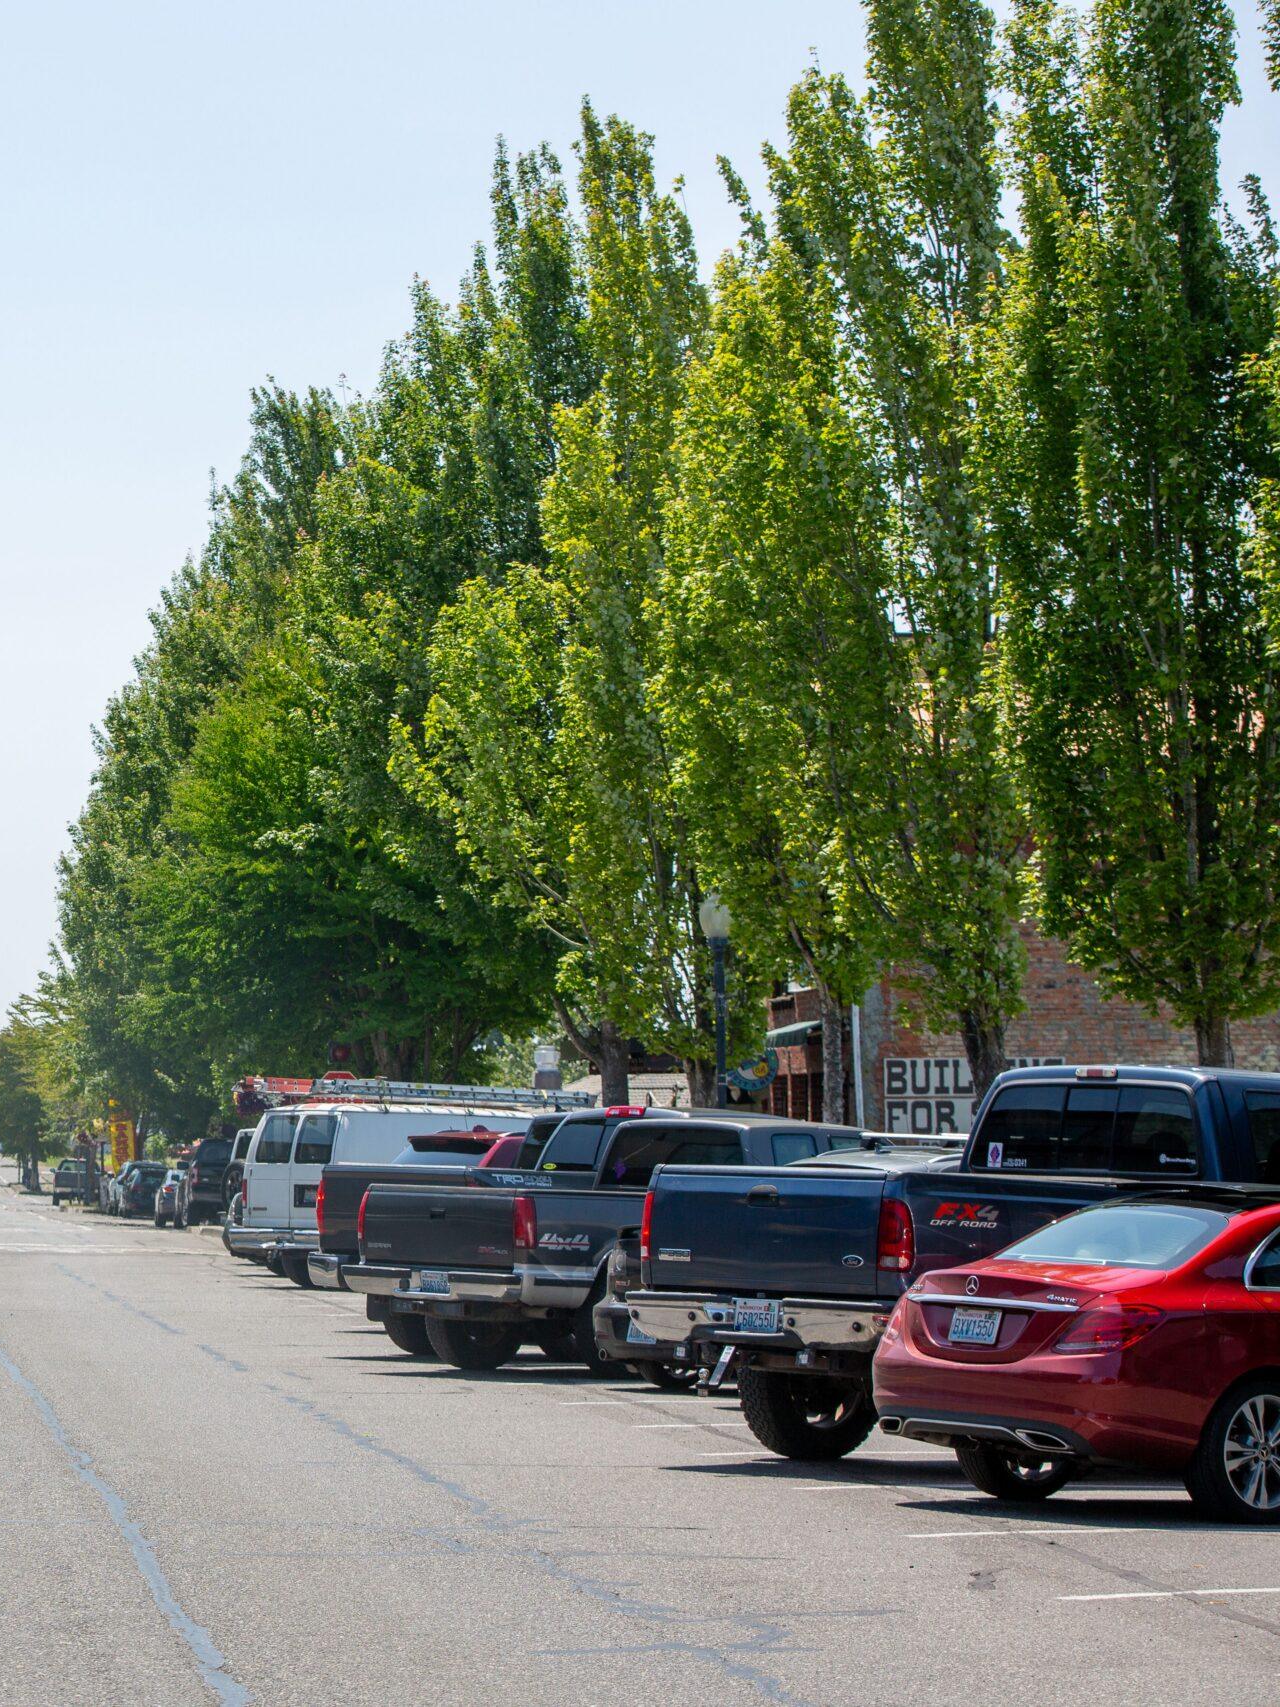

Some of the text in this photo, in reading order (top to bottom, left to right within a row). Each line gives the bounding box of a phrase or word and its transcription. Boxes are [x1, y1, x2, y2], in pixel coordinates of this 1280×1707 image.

[886, 1100, 959, 1135] FOR
[934, 1202, 1000, 1221] FX4
[929, 1219, 998, 1229] OFF ROAD
[736, 1311, 776, 1329] C60255U
